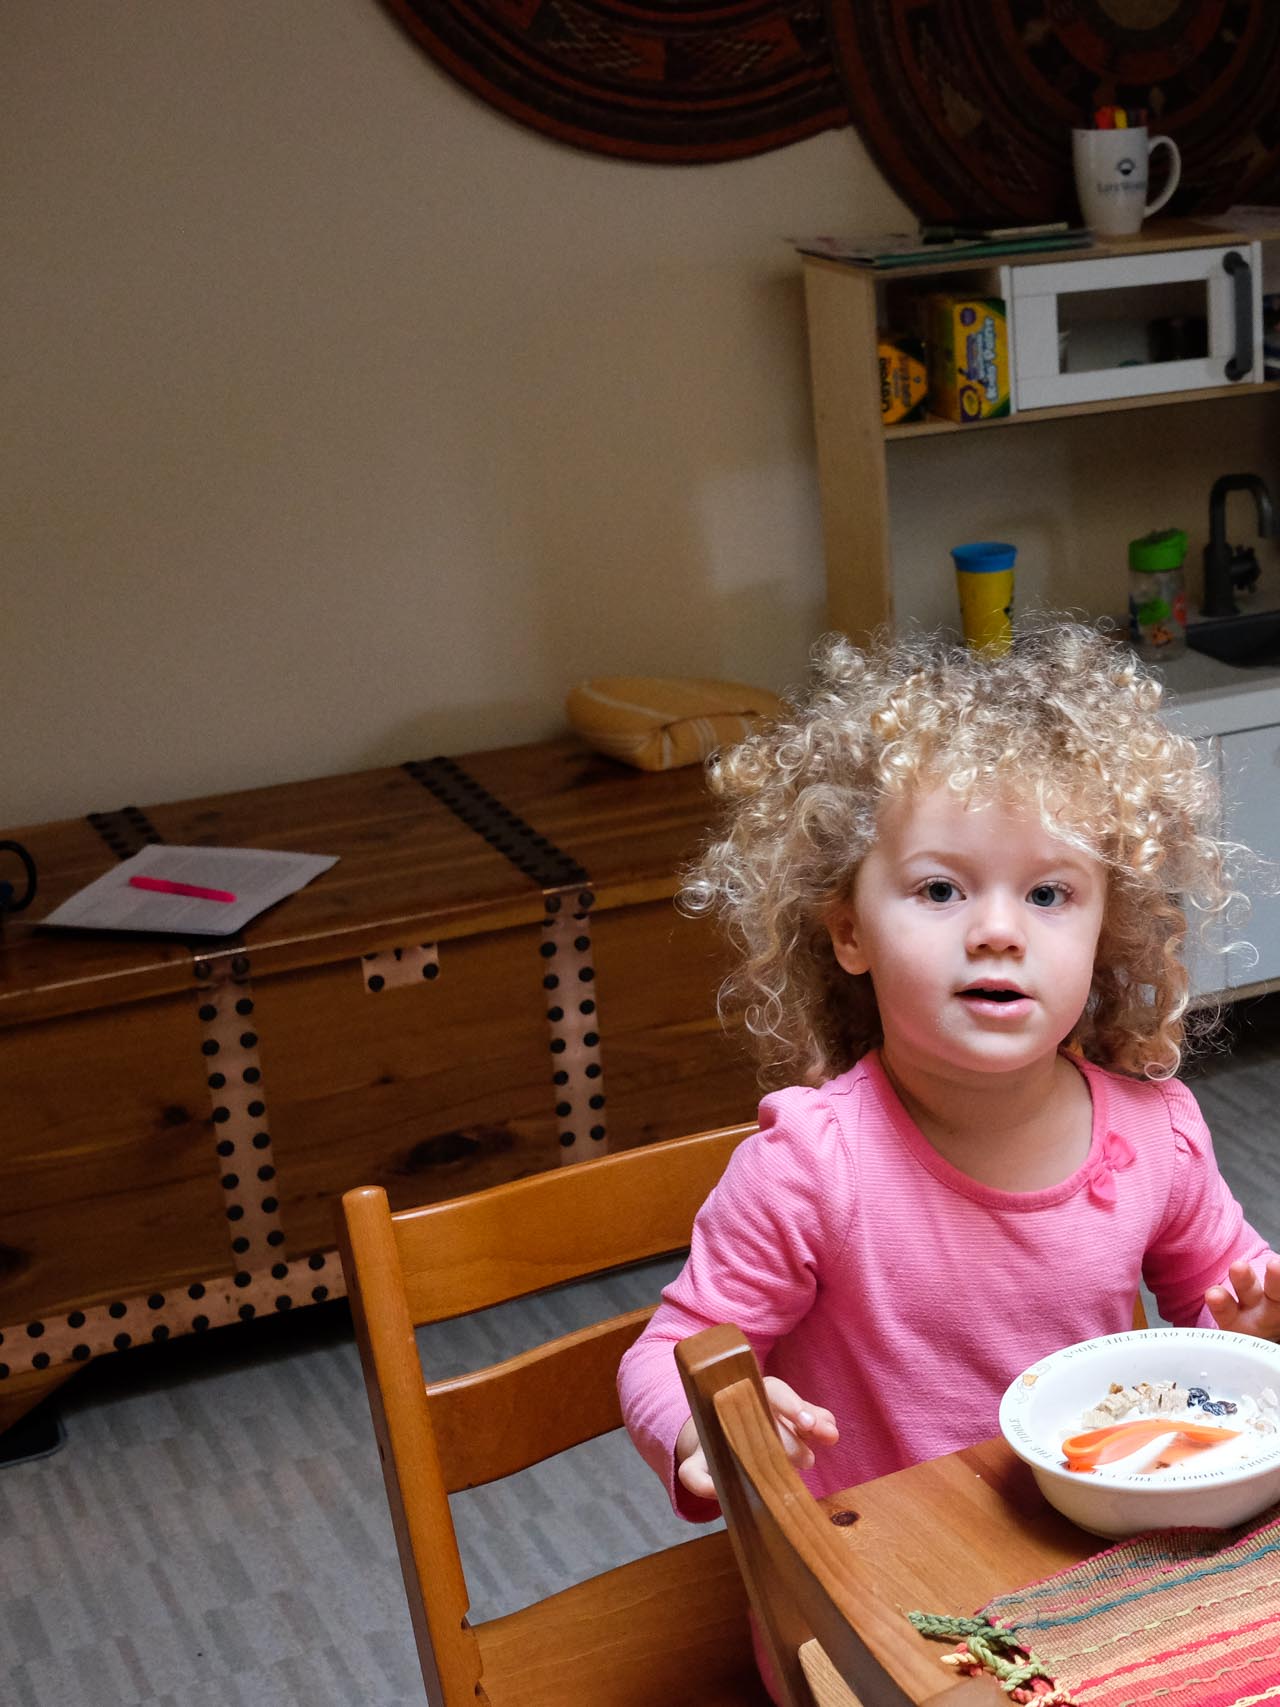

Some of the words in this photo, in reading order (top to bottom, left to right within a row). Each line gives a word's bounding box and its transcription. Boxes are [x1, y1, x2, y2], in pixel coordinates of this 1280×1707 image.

[1102, 1334, 1134, 1346] THE
[1139, 1331, 1180, 1339] OVER
[1186, 1332, 1246, 1344] JUMPED
[1250, 1341, 1277, 1354] COW
[1009, 1417, 1033, 1444] FIDDLE
[1030, 1446, 1053, 1460] THE
